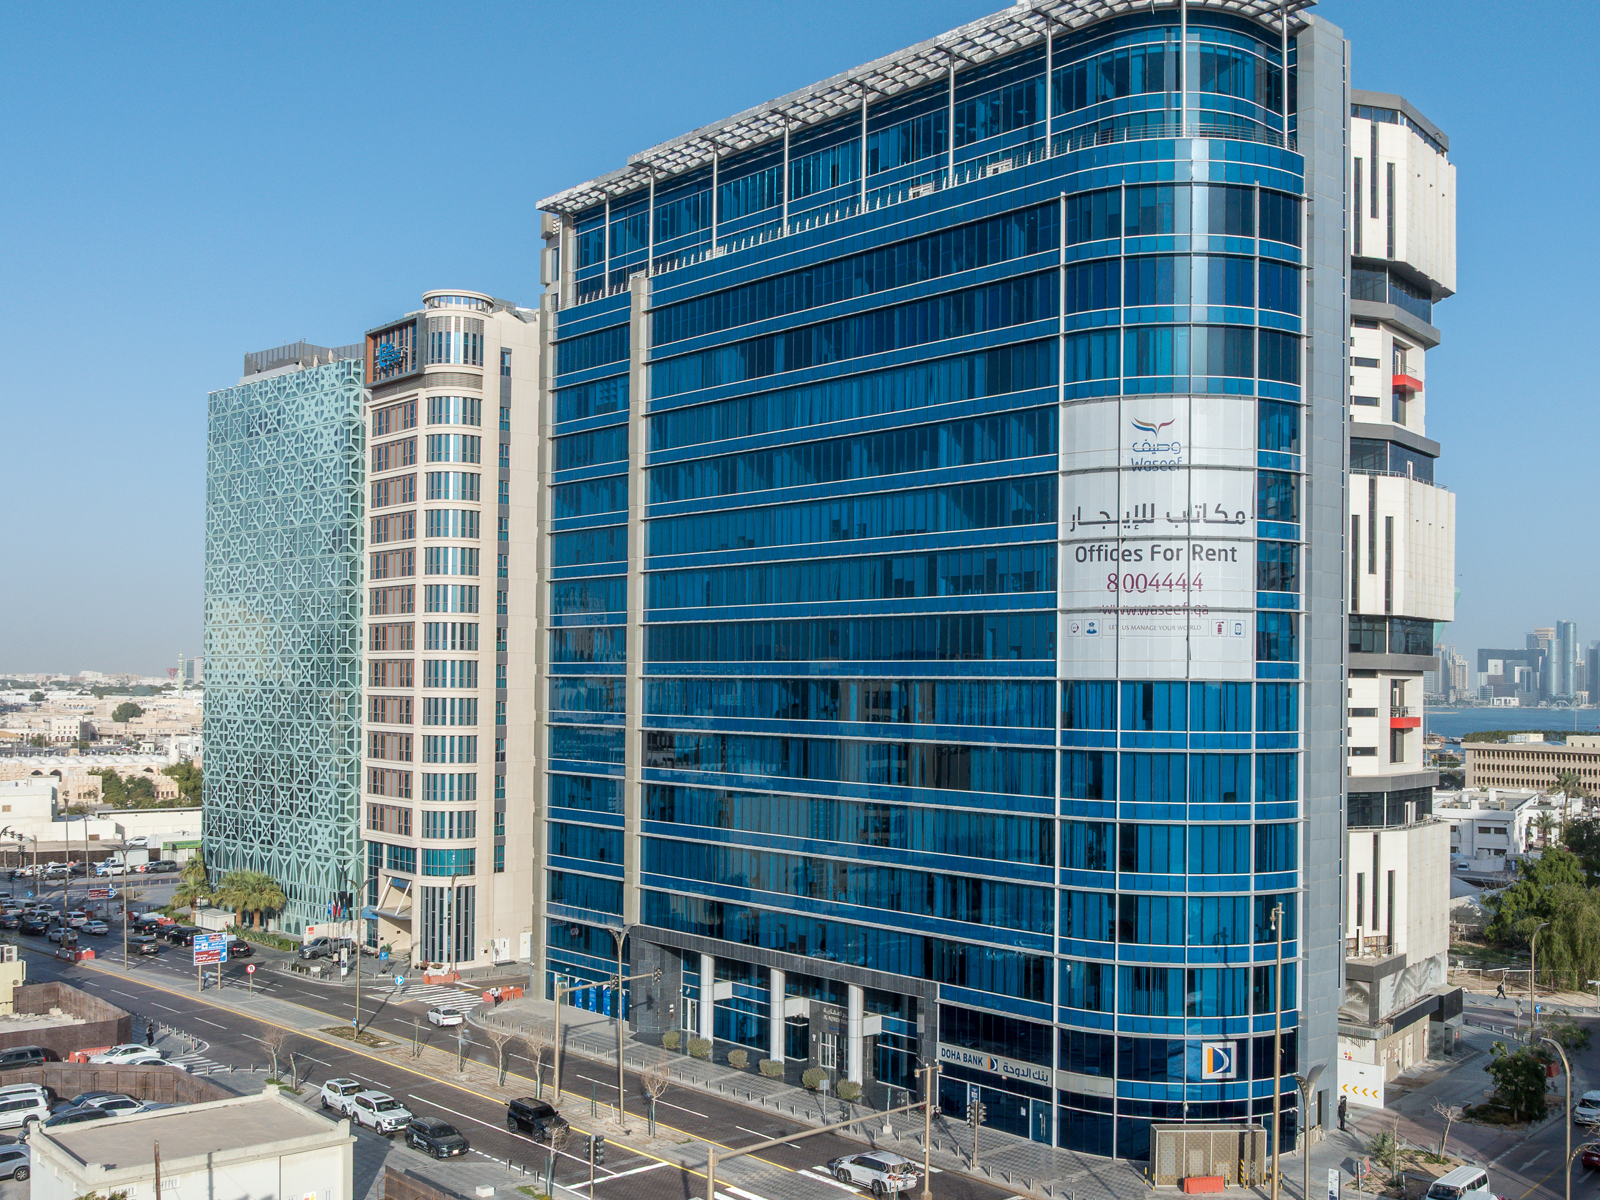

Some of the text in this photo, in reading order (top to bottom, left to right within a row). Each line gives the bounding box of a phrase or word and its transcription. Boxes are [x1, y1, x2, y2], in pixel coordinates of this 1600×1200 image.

[1132, 439, 1182, 454] وصيف
[1131, 456, 1182, 472] Waseef
[1070, 503, 1246, 532] مكاتب للإيجار
[1075, 544, 1237, 562] Offices For Rent
[1107, 572, 1203, 593] 8004444
[941, 1047, 984, 1067] DOHA BANK
[1003, 1062, 1049, 1085] بنك الدوحة
